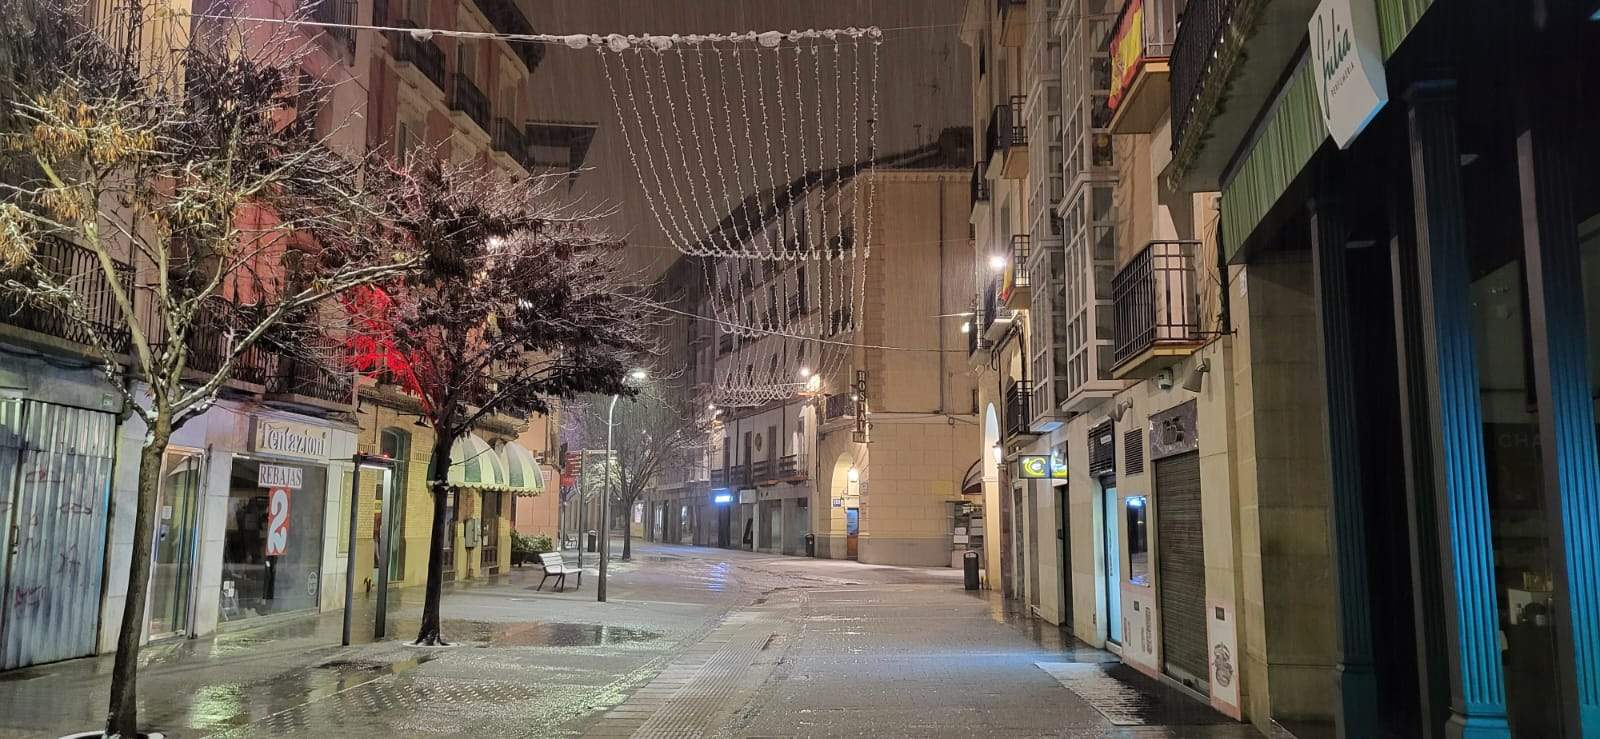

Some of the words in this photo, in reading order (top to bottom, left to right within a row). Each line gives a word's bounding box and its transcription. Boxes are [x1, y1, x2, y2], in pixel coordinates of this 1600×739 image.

[858, 370, 866, 432] HOSTAL
[258, 420, 327, 457] Tentazioni
[259, 464, 303, 487] REBAJAS
[267, 488, 289, 555] 2
